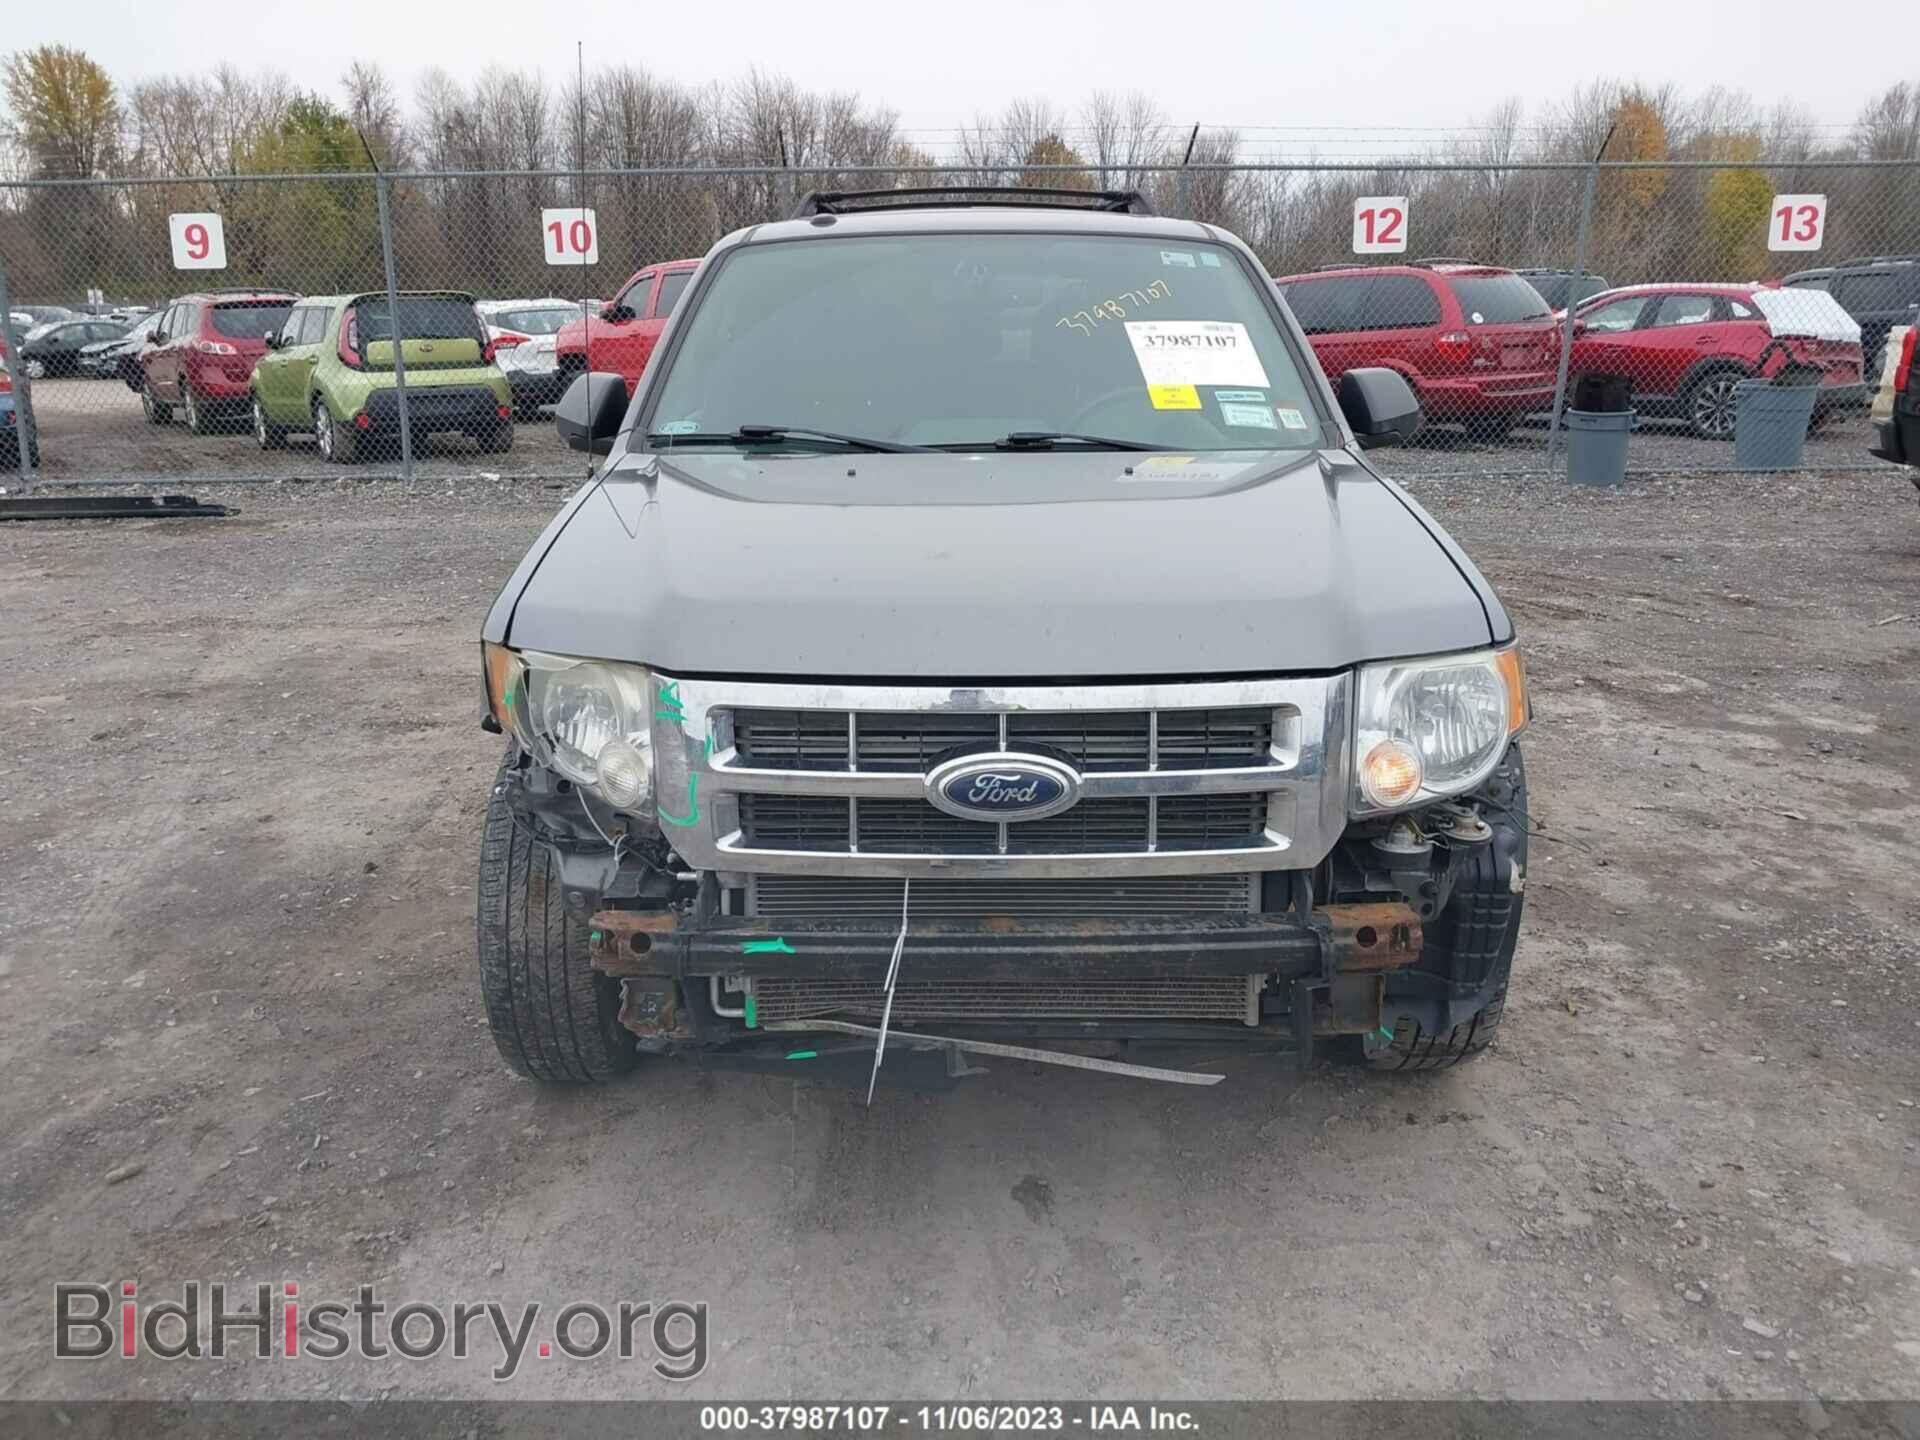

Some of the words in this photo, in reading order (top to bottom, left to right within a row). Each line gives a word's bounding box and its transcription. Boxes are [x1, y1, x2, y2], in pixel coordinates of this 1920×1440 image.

[548, 220, 592, 254] 10
[1359, 207, 1402, 244] 12
[1776, 205, 1819, 242] 13
[185, 224, 209, 260] 9
[1143, 334, 1238, 349] 37987107
[967, 773, 1040, 803] Ford
